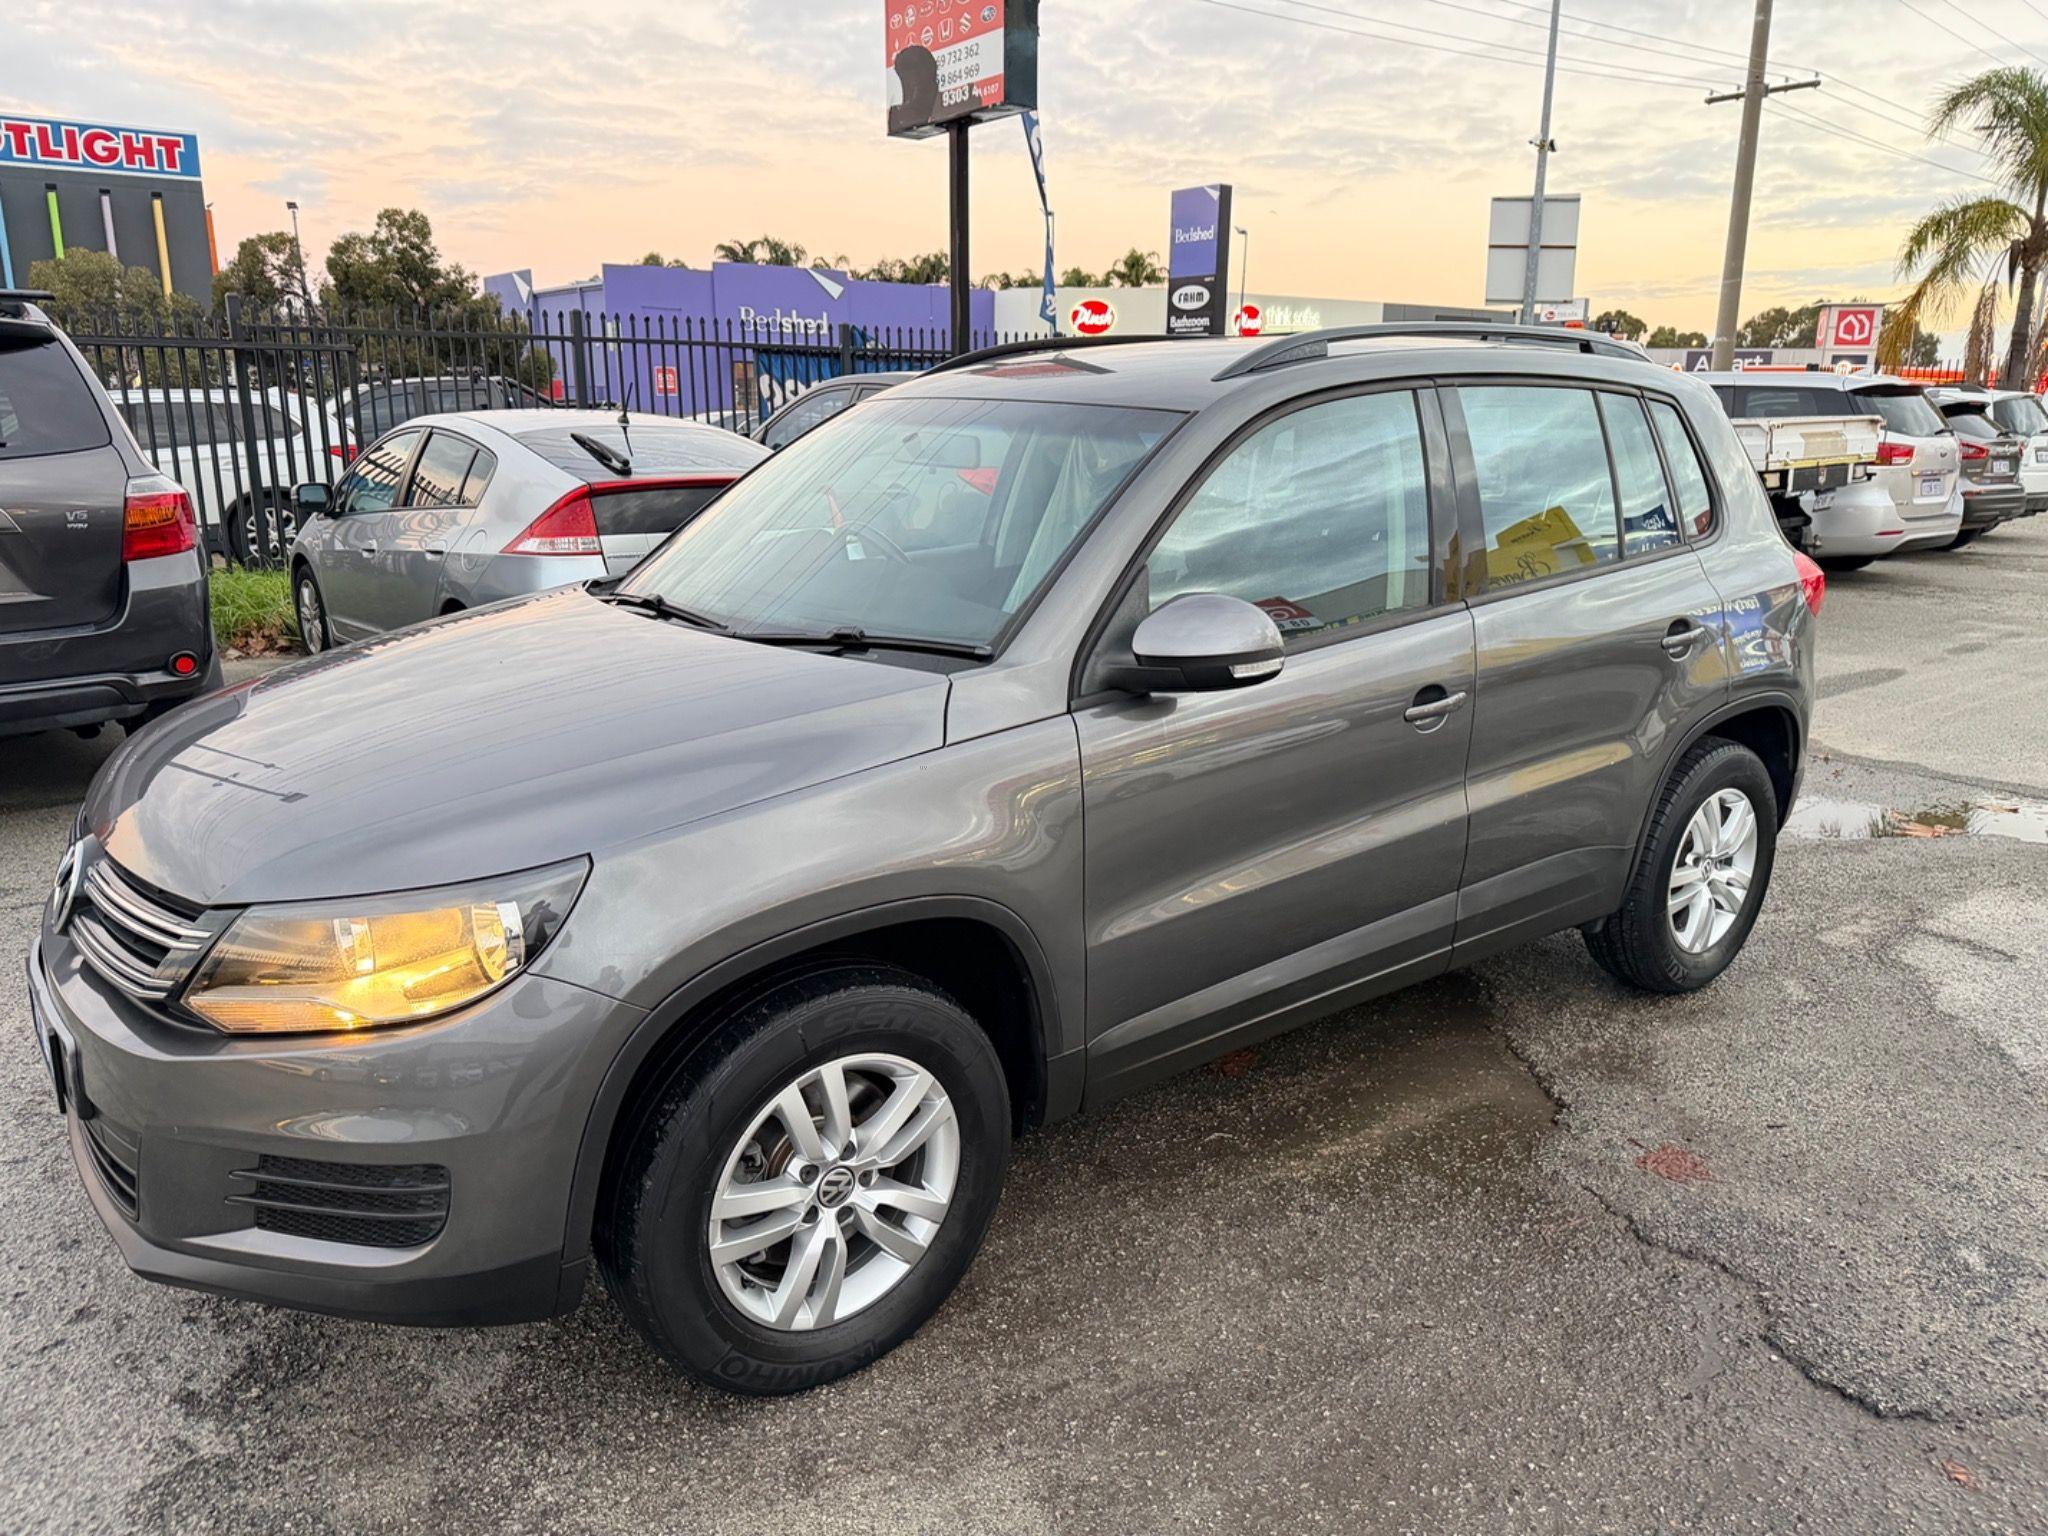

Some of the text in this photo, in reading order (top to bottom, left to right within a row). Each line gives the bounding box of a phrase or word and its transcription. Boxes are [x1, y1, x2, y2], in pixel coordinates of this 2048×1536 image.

[947, 48, 962, 65] 732
[964, 42, 980, 60] 362
[947, 69, 963, 85] 864
[964, 63, 980, 80] 969
[942, 85, 969, 107] 9303
[0, 120, 184, 173] TLIGHT
[1175, 225, 1215, 244] Bedshed
[738, 305, 829, 336] Bedshed
[1072, 306, 1114, 327] Plush
[1170, 314, 1210, 328] Bathroom
[65, 510, 89, 522] V6
